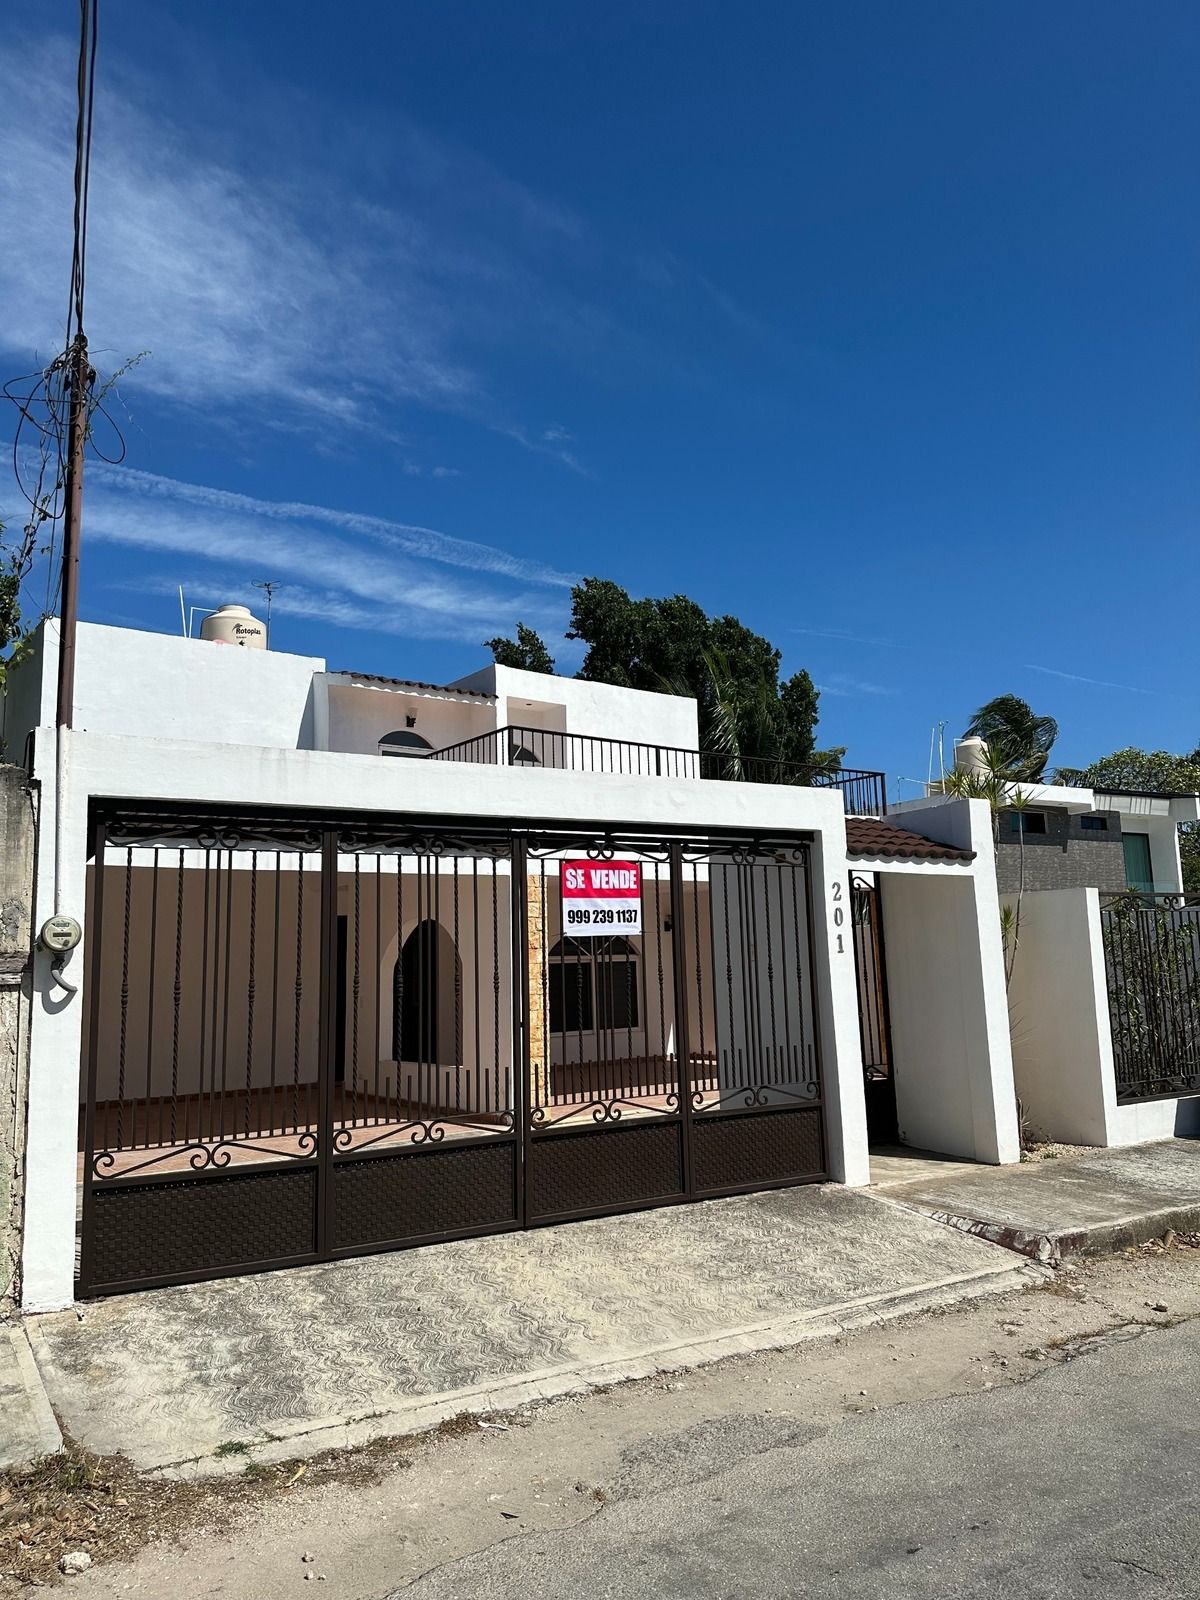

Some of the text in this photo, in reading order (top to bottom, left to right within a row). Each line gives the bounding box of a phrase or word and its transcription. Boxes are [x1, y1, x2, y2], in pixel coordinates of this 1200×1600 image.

[235, 627, 261, 636] Rotoplas
[565, 868, 638, 889] SE VENDE
[567, 909, 638, 924] 999 239 1137
[832, 882, 844, 954] 201
